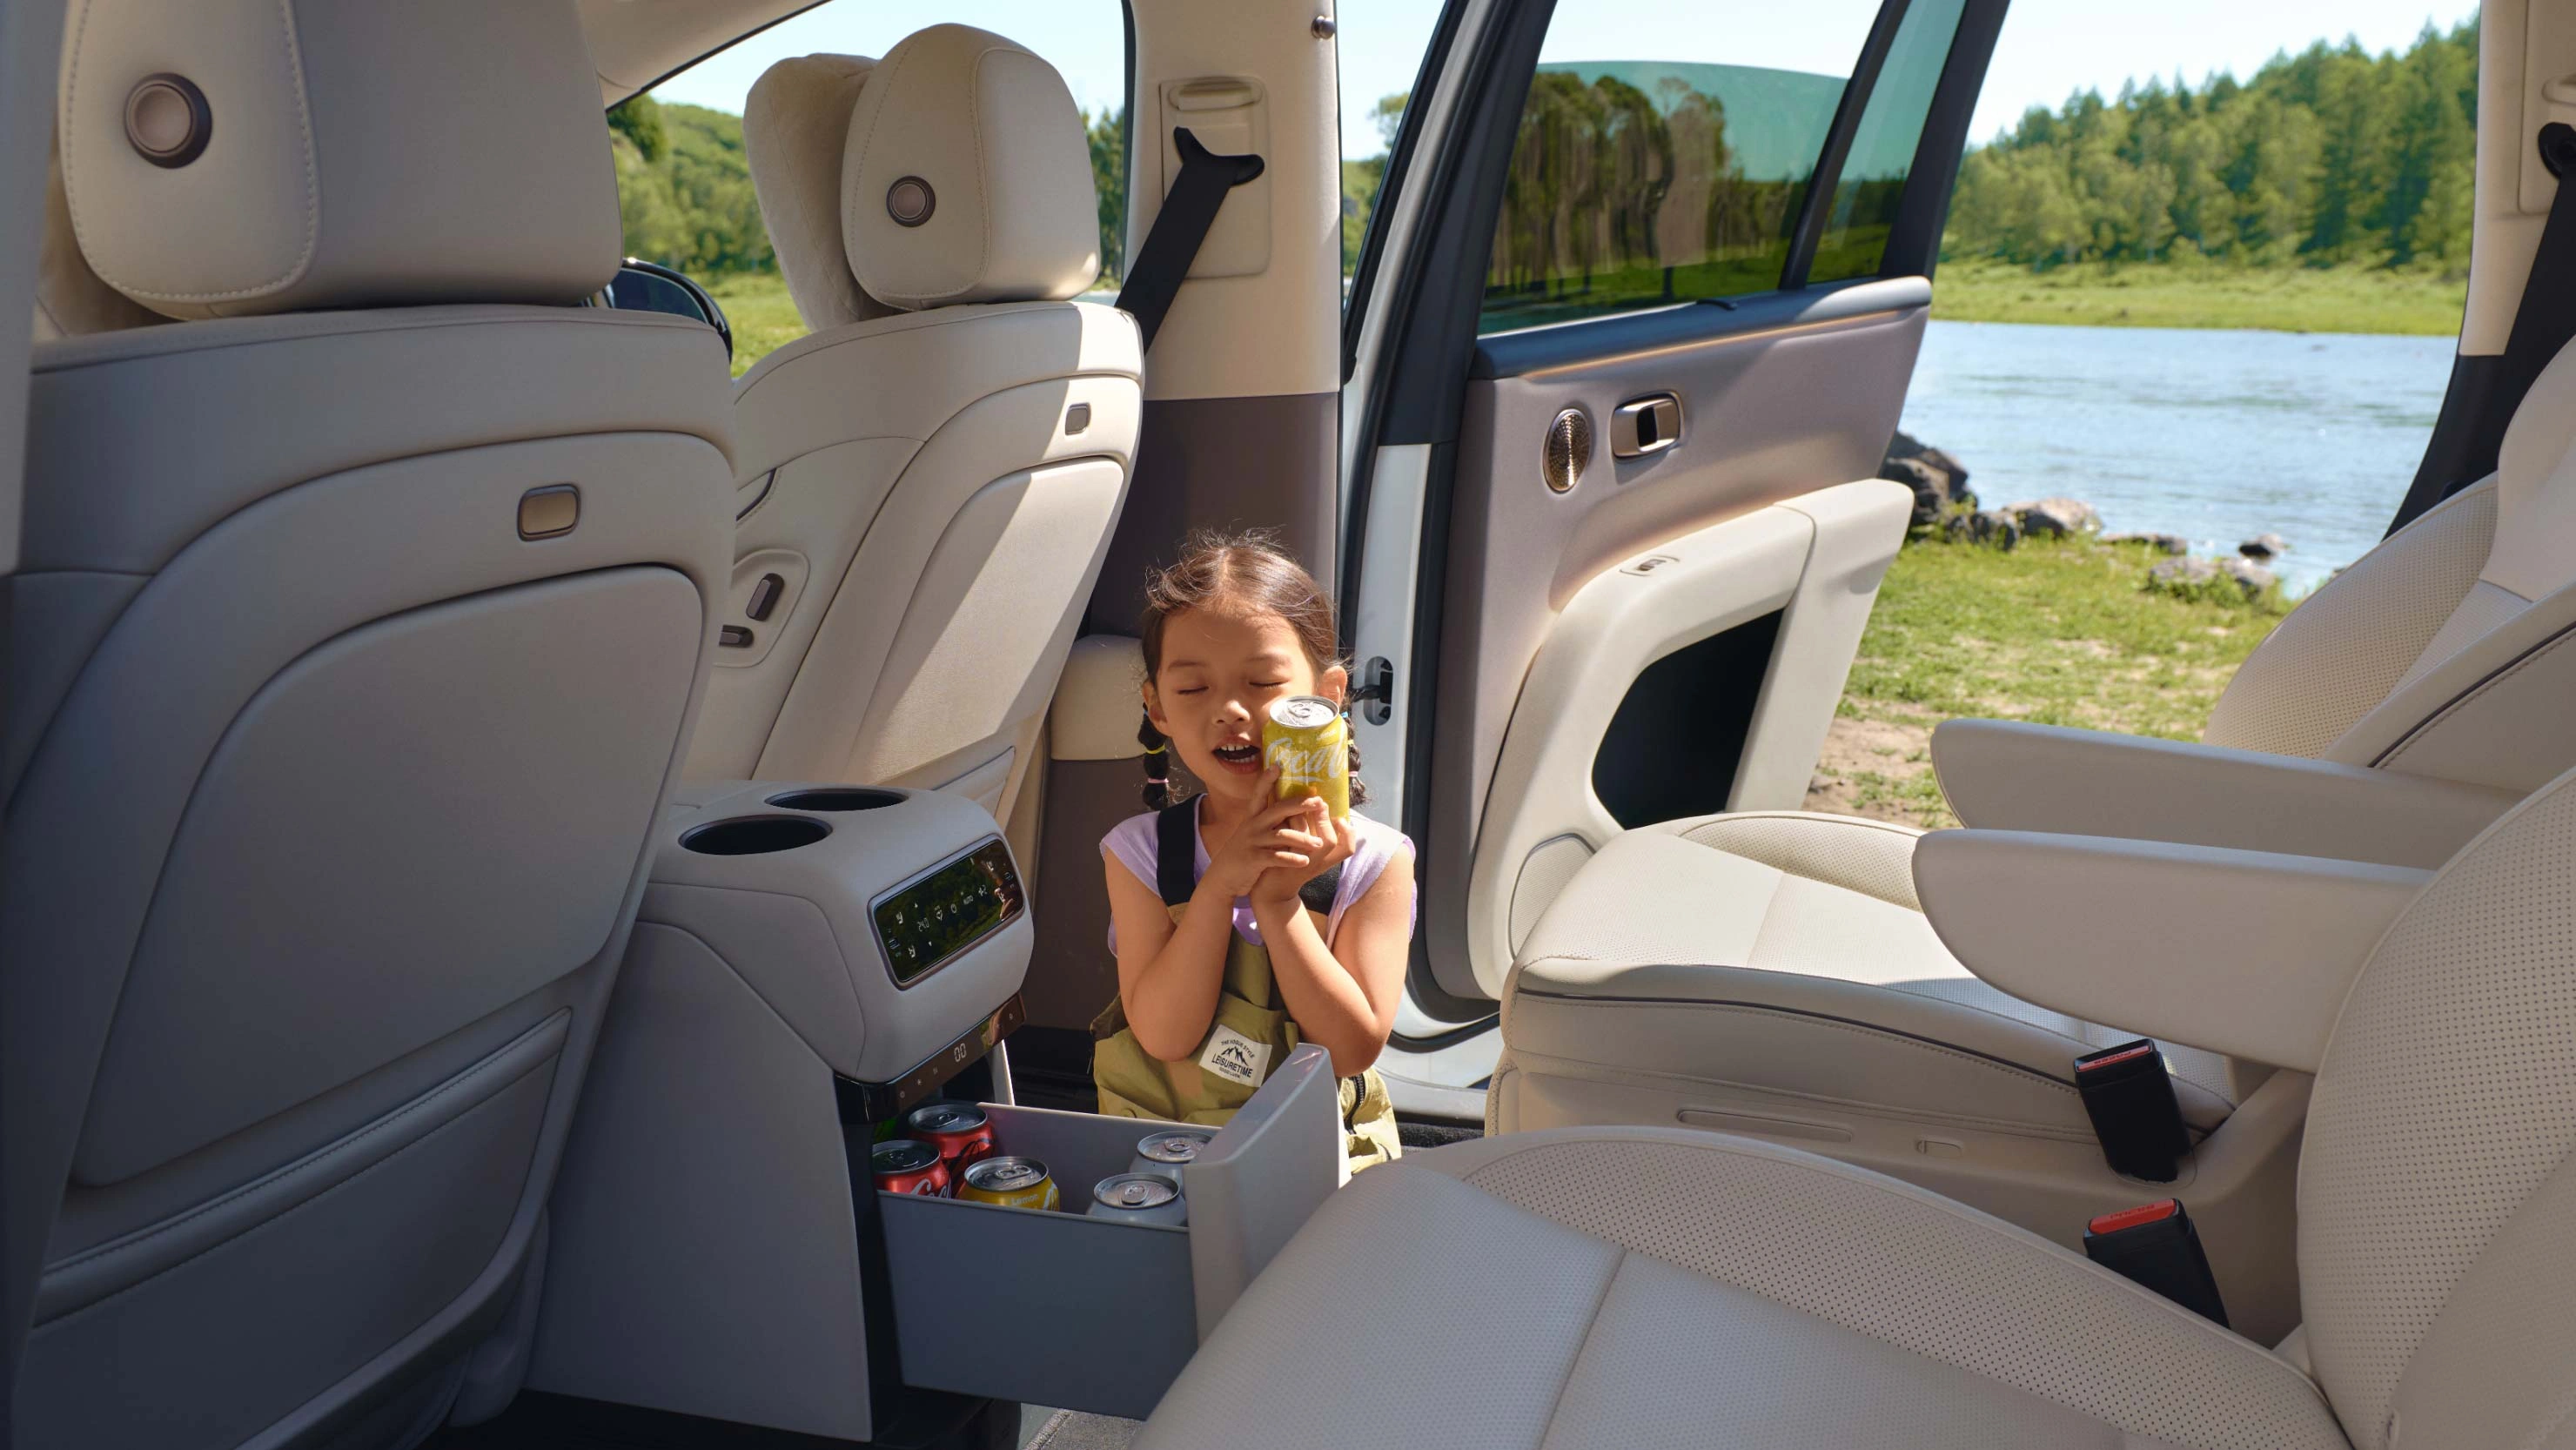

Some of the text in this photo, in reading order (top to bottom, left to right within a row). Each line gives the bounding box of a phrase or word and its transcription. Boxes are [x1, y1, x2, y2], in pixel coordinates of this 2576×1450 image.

[954, 1043, 967, 1063] 00
[1243, 1045, 1255, 1058] STYLE
[1211, 1053, 1253, 1077] LEISURETIME
[1011, 1194, 1038, 1206] Lemon
